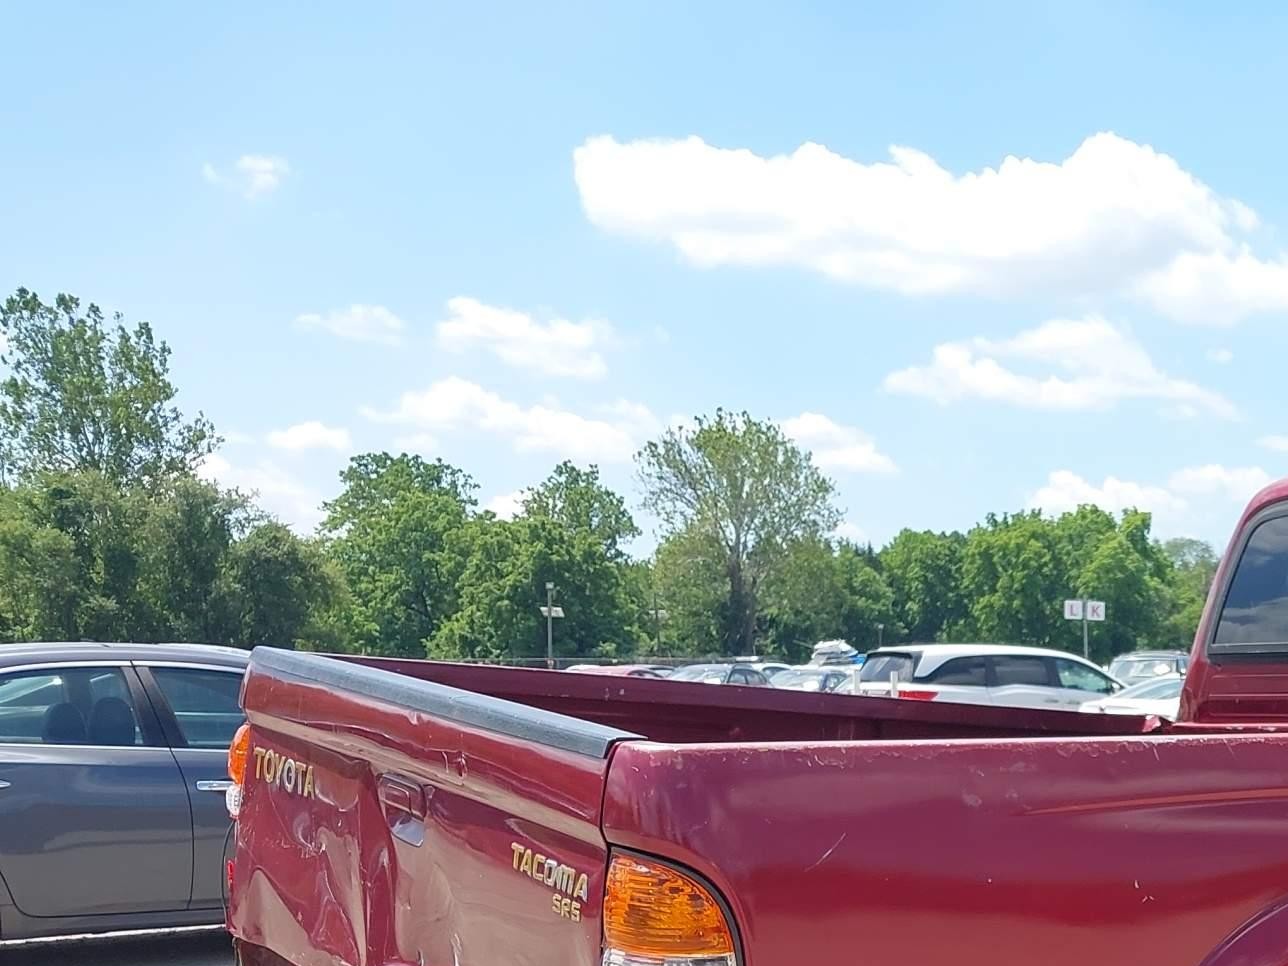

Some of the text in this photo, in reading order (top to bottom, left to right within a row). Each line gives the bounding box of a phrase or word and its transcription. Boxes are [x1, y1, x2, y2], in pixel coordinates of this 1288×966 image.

[1091, 605, 1101, 618] K
[254, 746, 315, 800] TOYOTA
[511, 841, 588, 902] TACOMA
